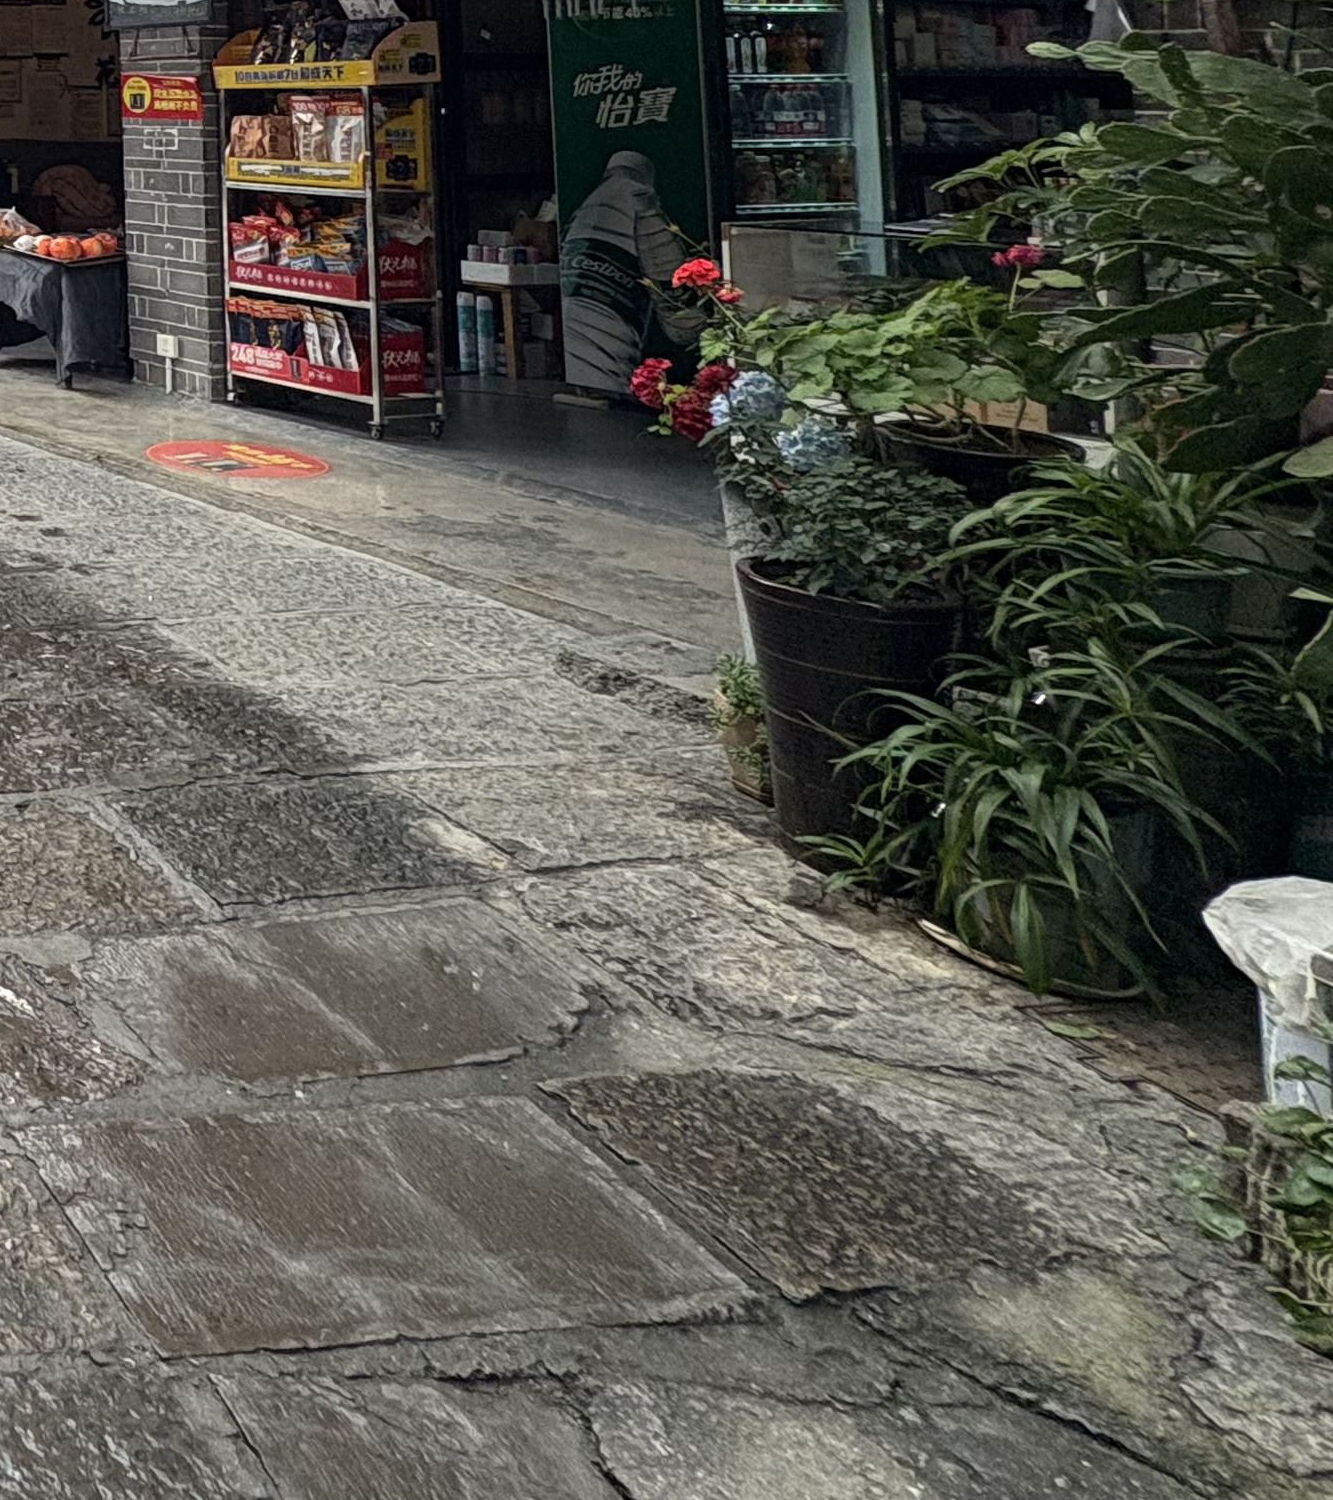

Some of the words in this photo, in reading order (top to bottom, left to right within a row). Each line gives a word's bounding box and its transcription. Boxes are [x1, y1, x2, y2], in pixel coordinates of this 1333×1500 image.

[573, 63, 643, 97] 你我的
[231, 344, 254, 364] 248
